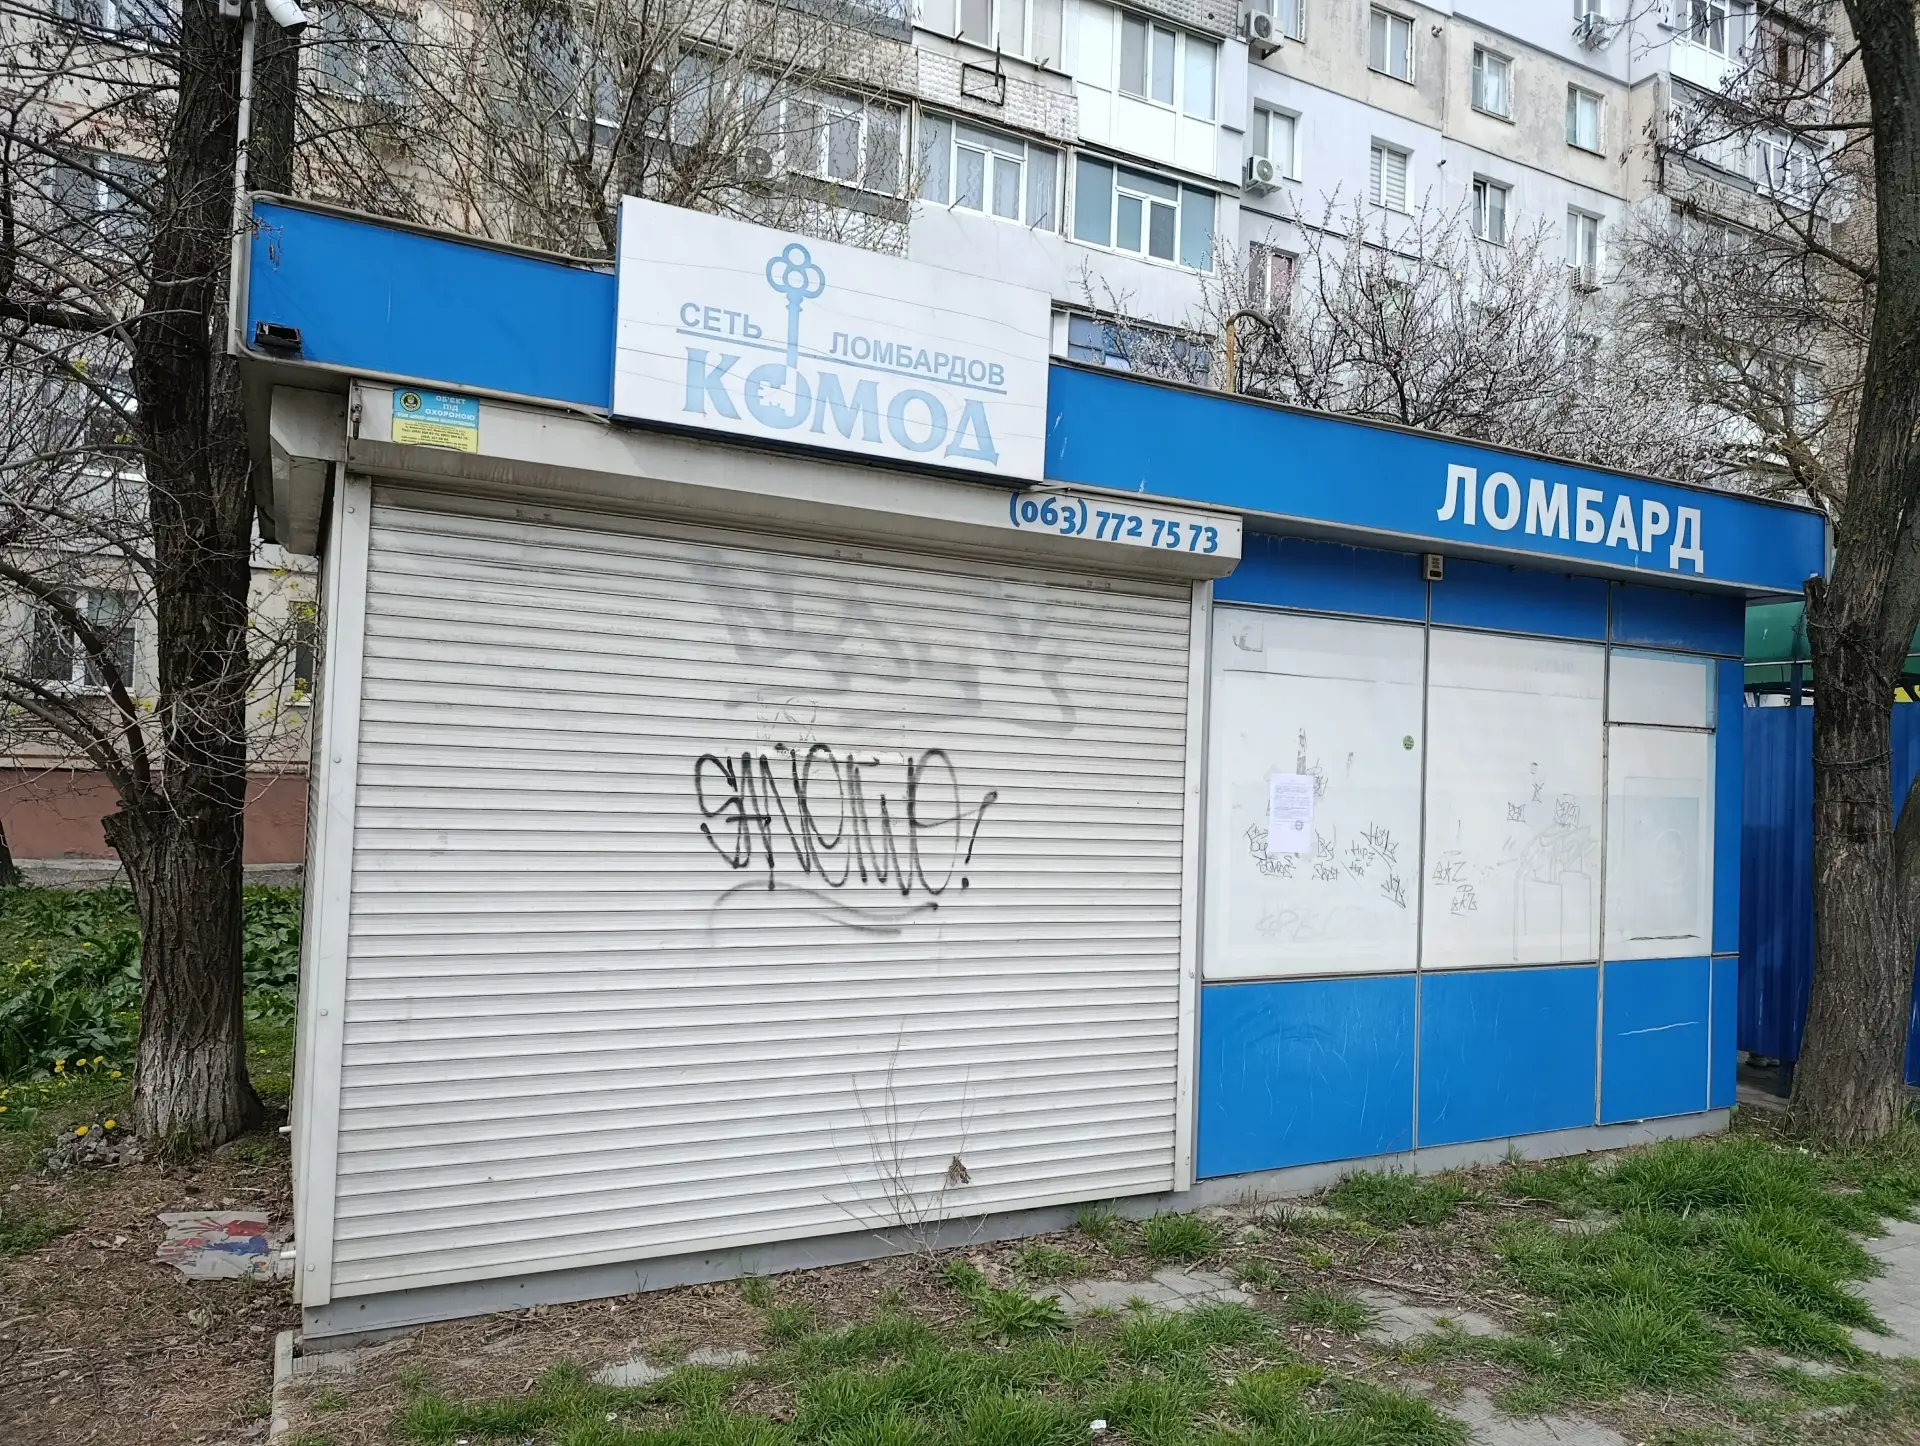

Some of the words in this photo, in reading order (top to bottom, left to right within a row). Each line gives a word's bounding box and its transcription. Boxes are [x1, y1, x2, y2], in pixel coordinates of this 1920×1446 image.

[680, 302, 762, 340] СЕТЬ
[828, 332, 1006, 386] ЛОМБАРДОВ
[425, 408, 475, 421] ОХОРОНОЮ
[682, 346, 1000, 467] КОМОД
[1009, 491, 1088, 536] (063)
[1096, 510, 1143, 542] 772
[1151, 518, 1181, 549] 75
[1188, 524, 1219, 554] 73
[1436, 463, 1704, 574] ЛОМБАРД
